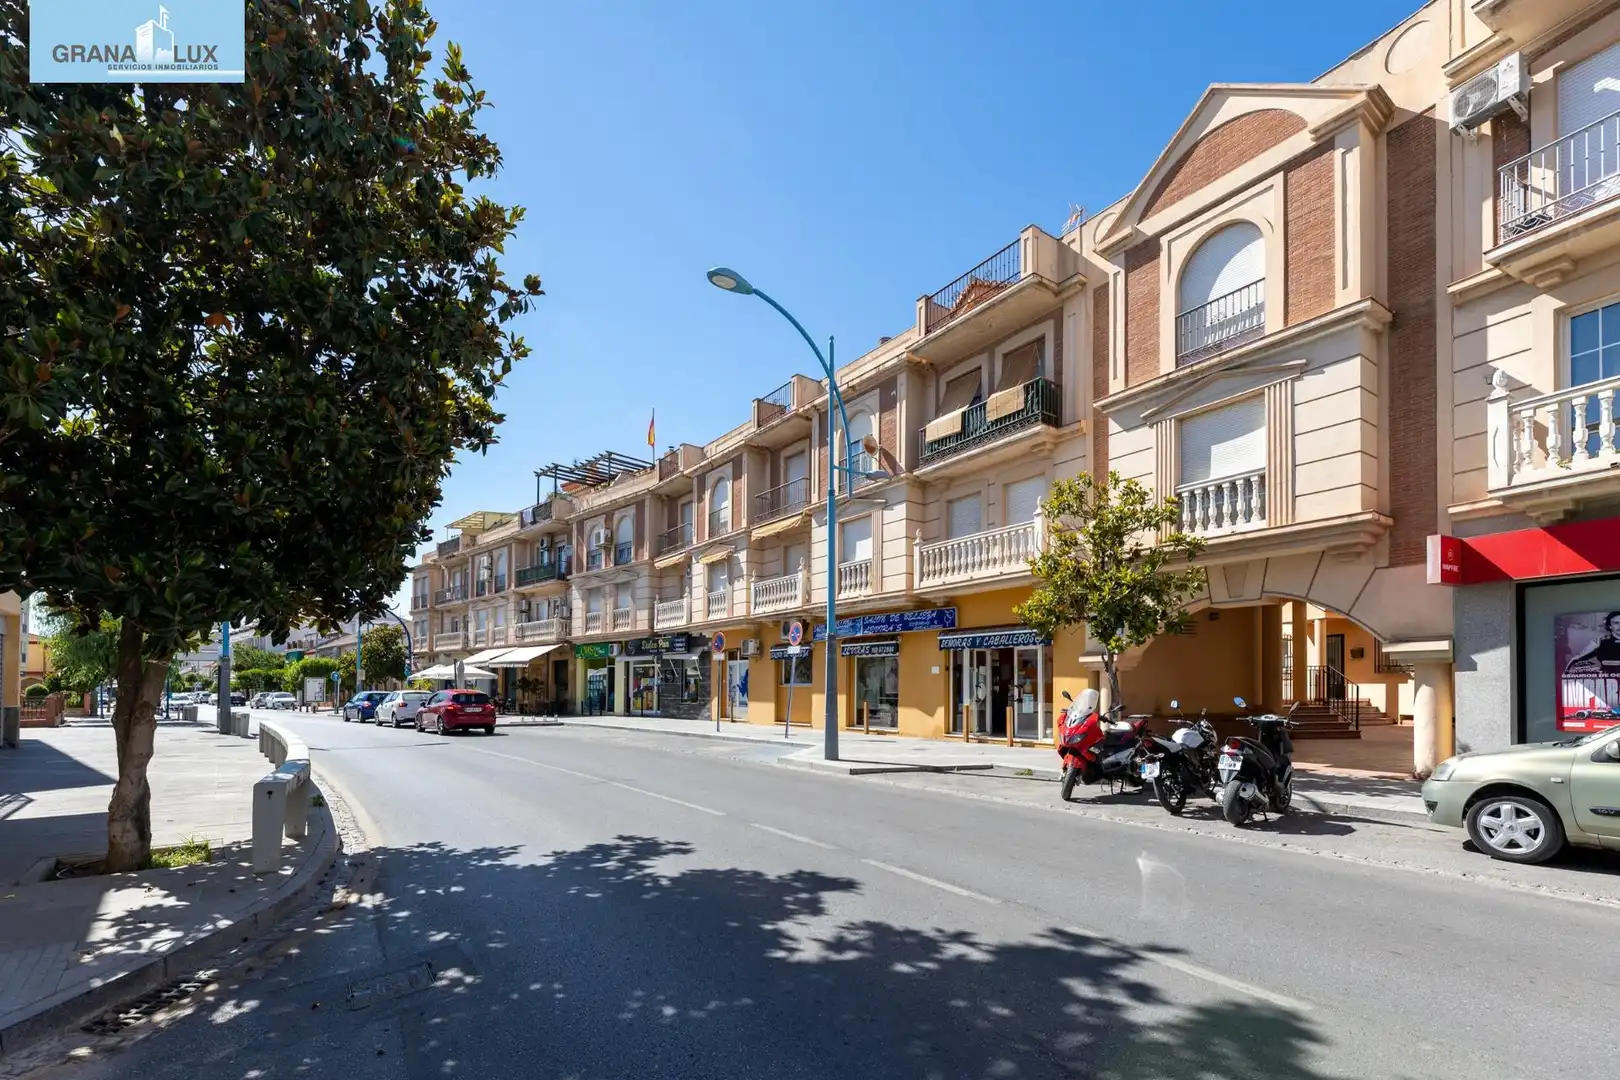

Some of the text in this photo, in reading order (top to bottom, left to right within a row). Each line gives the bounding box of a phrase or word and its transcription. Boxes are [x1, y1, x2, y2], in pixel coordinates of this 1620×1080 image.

[1442, 563, 1460, 572] MAPFRE
[889, 613, 901, 622] DE
[983, 632, 1036, 646] CABALLEROS
